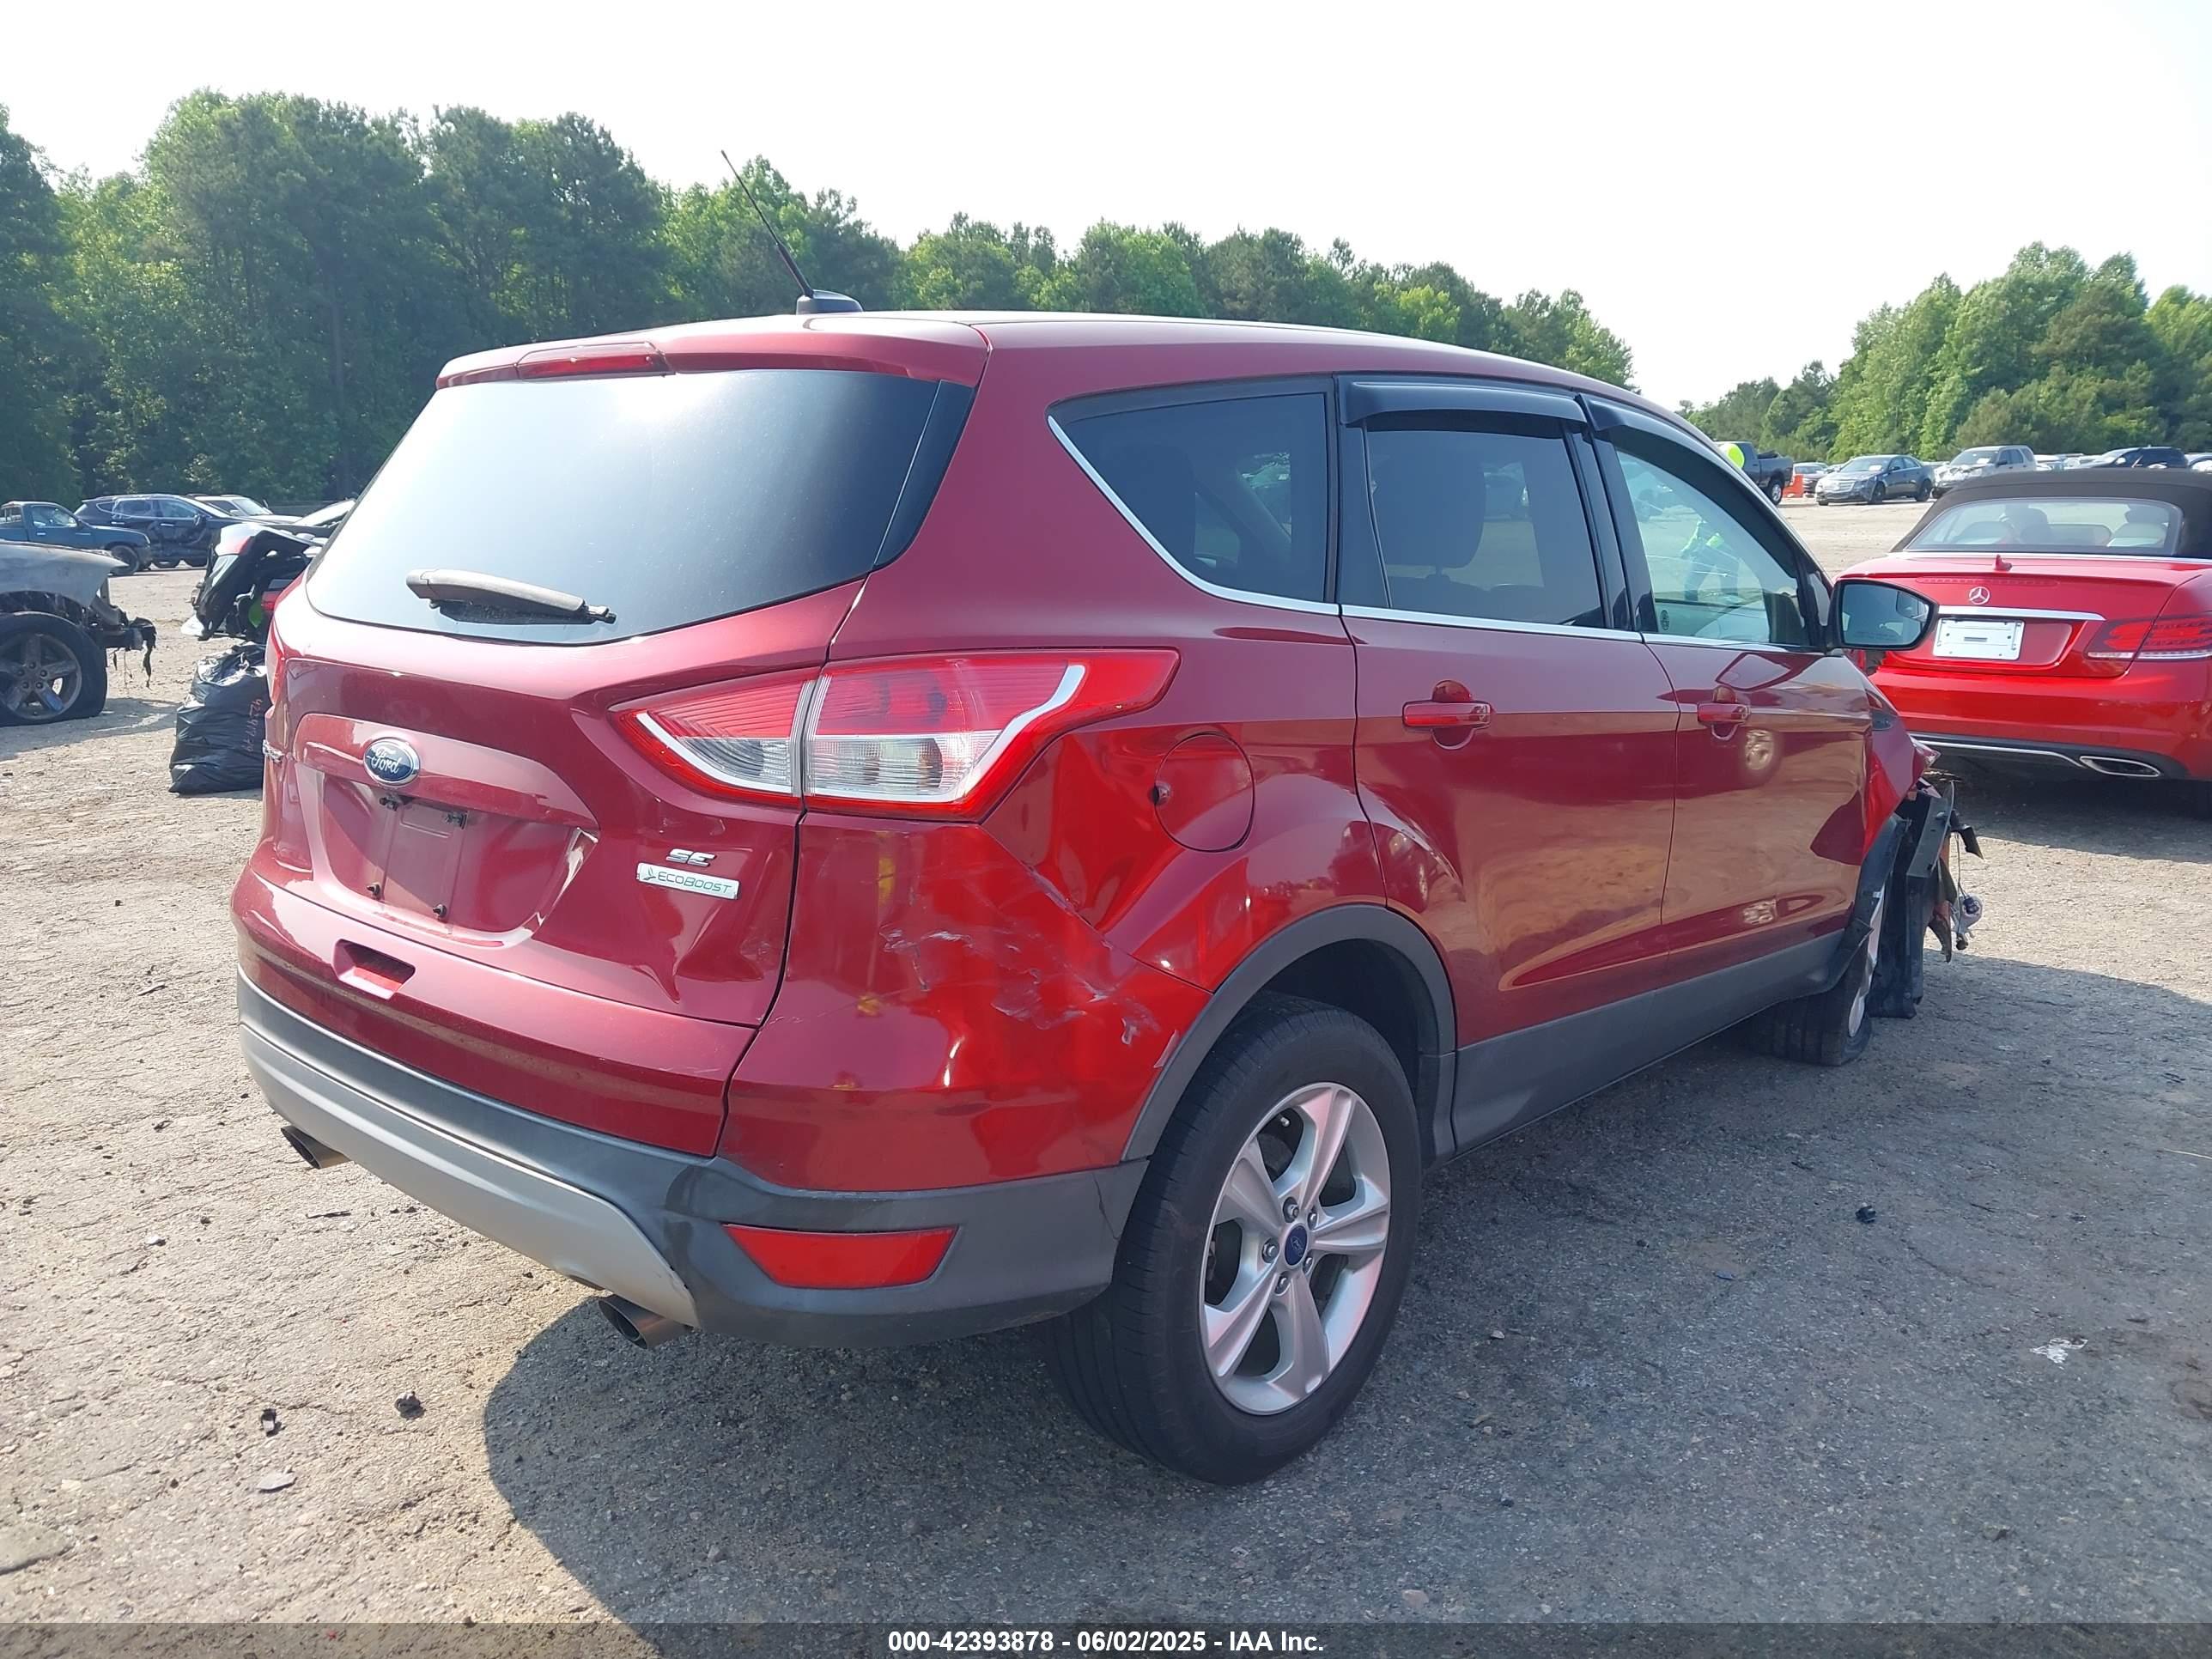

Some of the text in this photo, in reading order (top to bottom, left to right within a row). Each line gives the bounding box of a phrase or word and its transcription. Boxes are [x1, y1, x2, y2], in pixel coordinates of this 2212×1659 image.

[366, 748, 403, 774] Ford
[665, 848, 717, 867] SE
[658, 871, 732, 894] ECOBOOST
